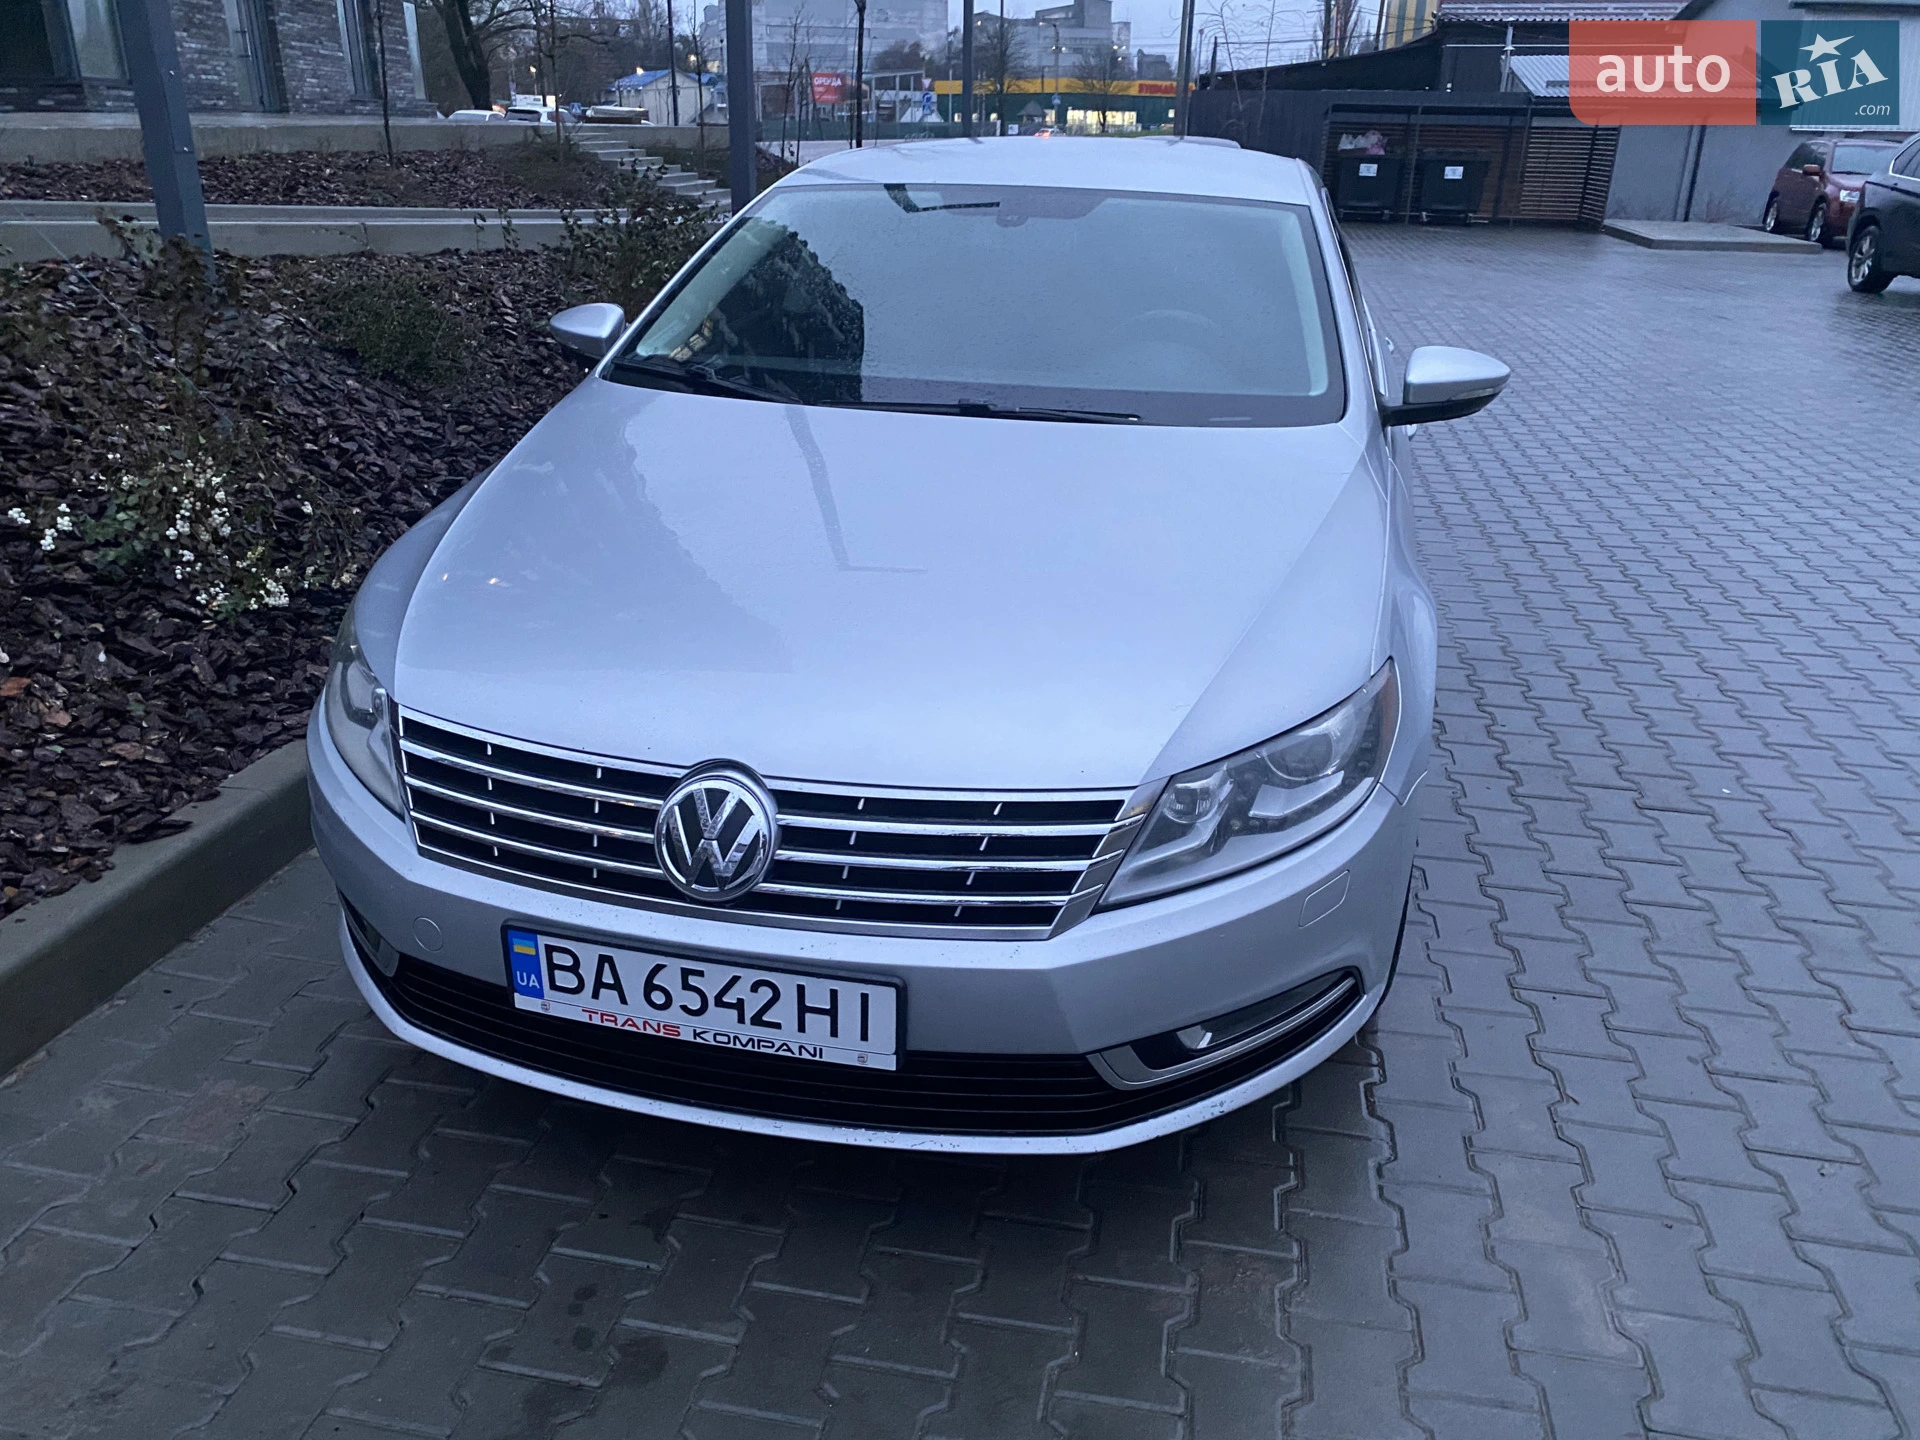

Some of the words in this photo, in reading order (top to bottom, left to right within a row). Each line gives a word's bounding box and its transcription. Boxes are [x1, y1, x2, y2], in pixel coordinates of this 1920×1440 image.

[662, 783, 764, 892] VW
[516, 971, 540, 989] UA
[581, 1008, 681, 1038] TRANS
[692, 1028, 824, 1059] KOMPANI
